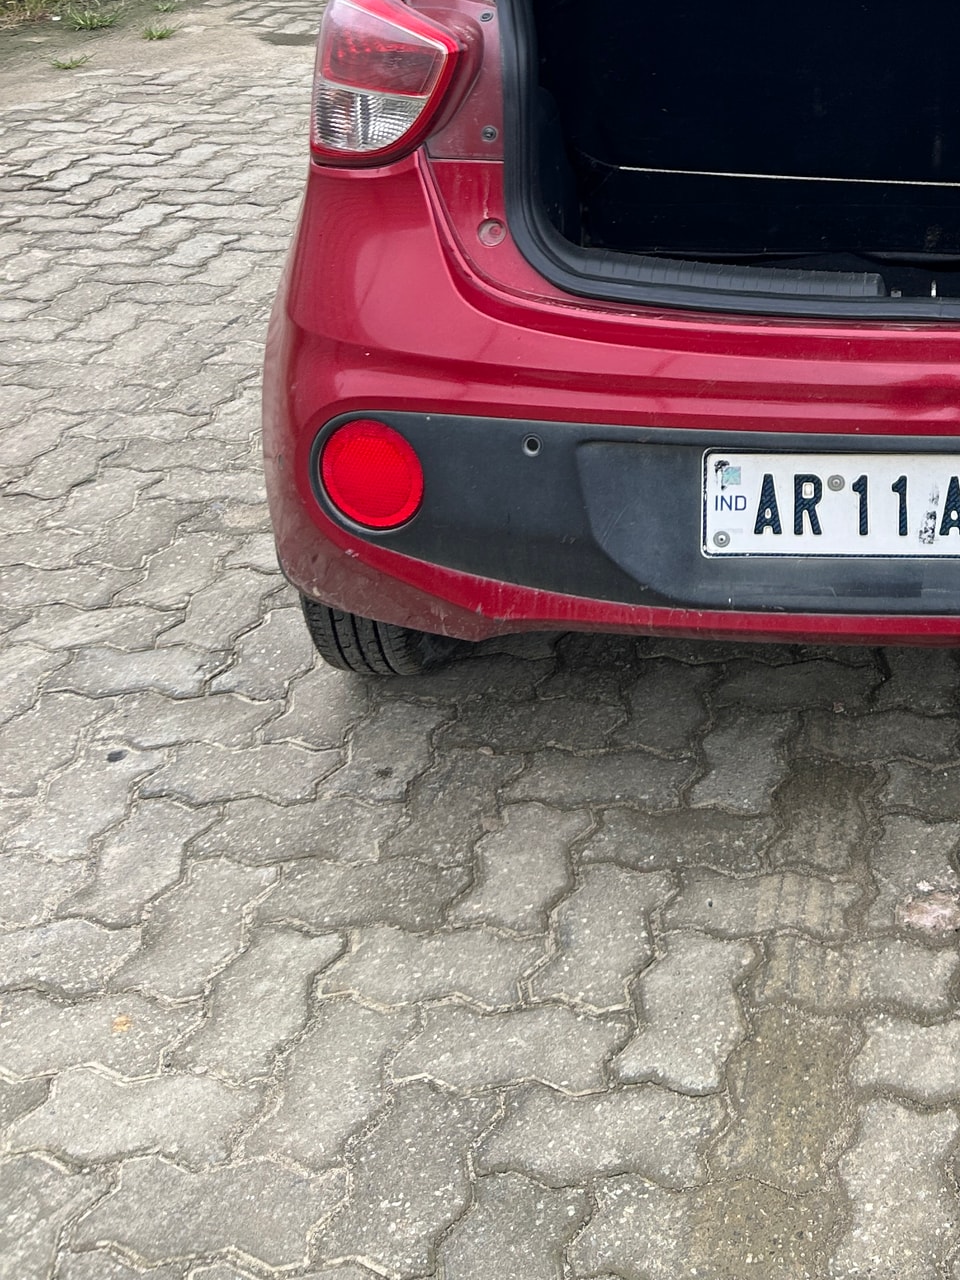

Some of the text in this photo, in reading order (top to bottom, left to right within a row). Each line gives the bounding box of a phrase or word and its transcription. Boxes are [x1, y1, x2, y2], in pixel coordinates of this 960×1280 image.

[715, 495, 747, 511] IND
[754, 473, 822, 536] AR
[852, 474, 908, 536] 11
